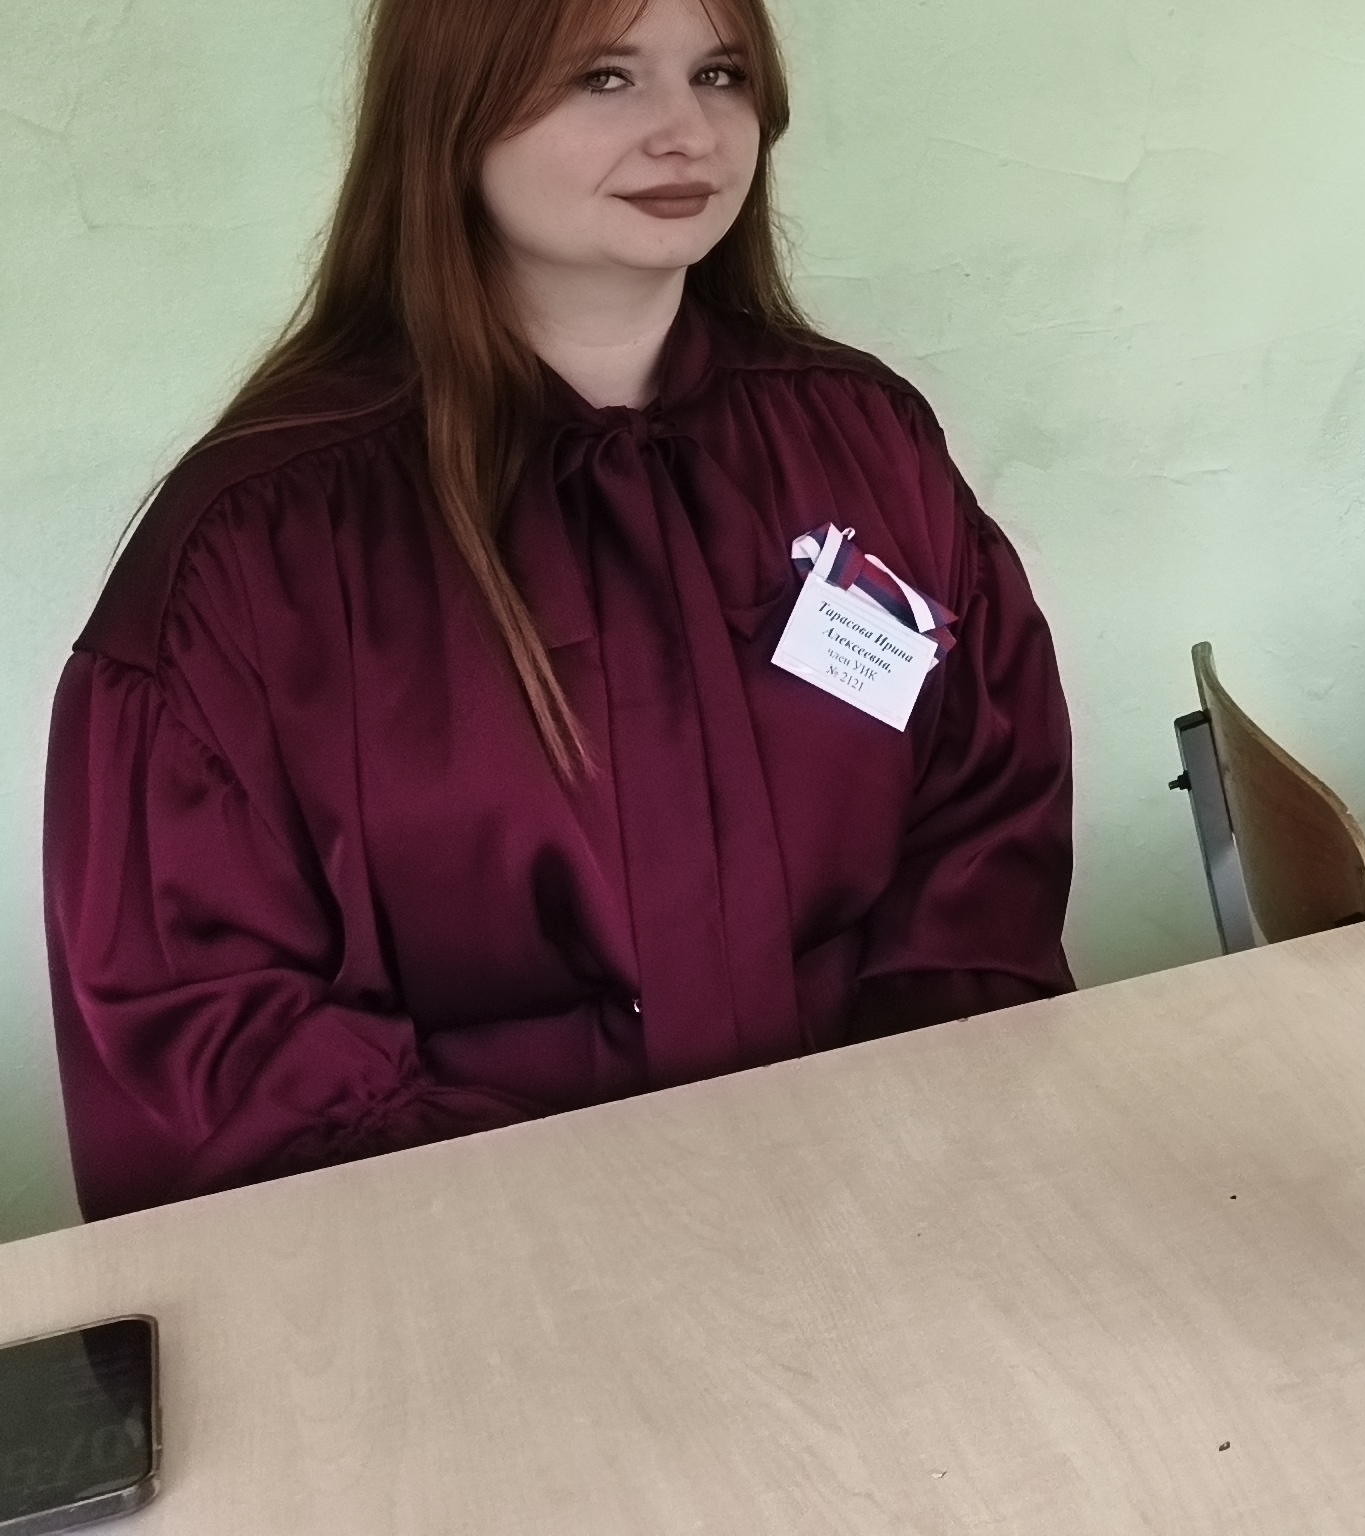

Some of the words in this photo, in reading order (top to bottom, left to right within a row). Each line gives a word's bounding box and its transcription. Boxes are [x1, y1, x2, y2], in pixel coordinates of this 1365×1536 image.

[817, 600, 873, 639] Тарасова
[875, 633, 913, 663] Ирина
[853, 660, 878, 681] УИК
